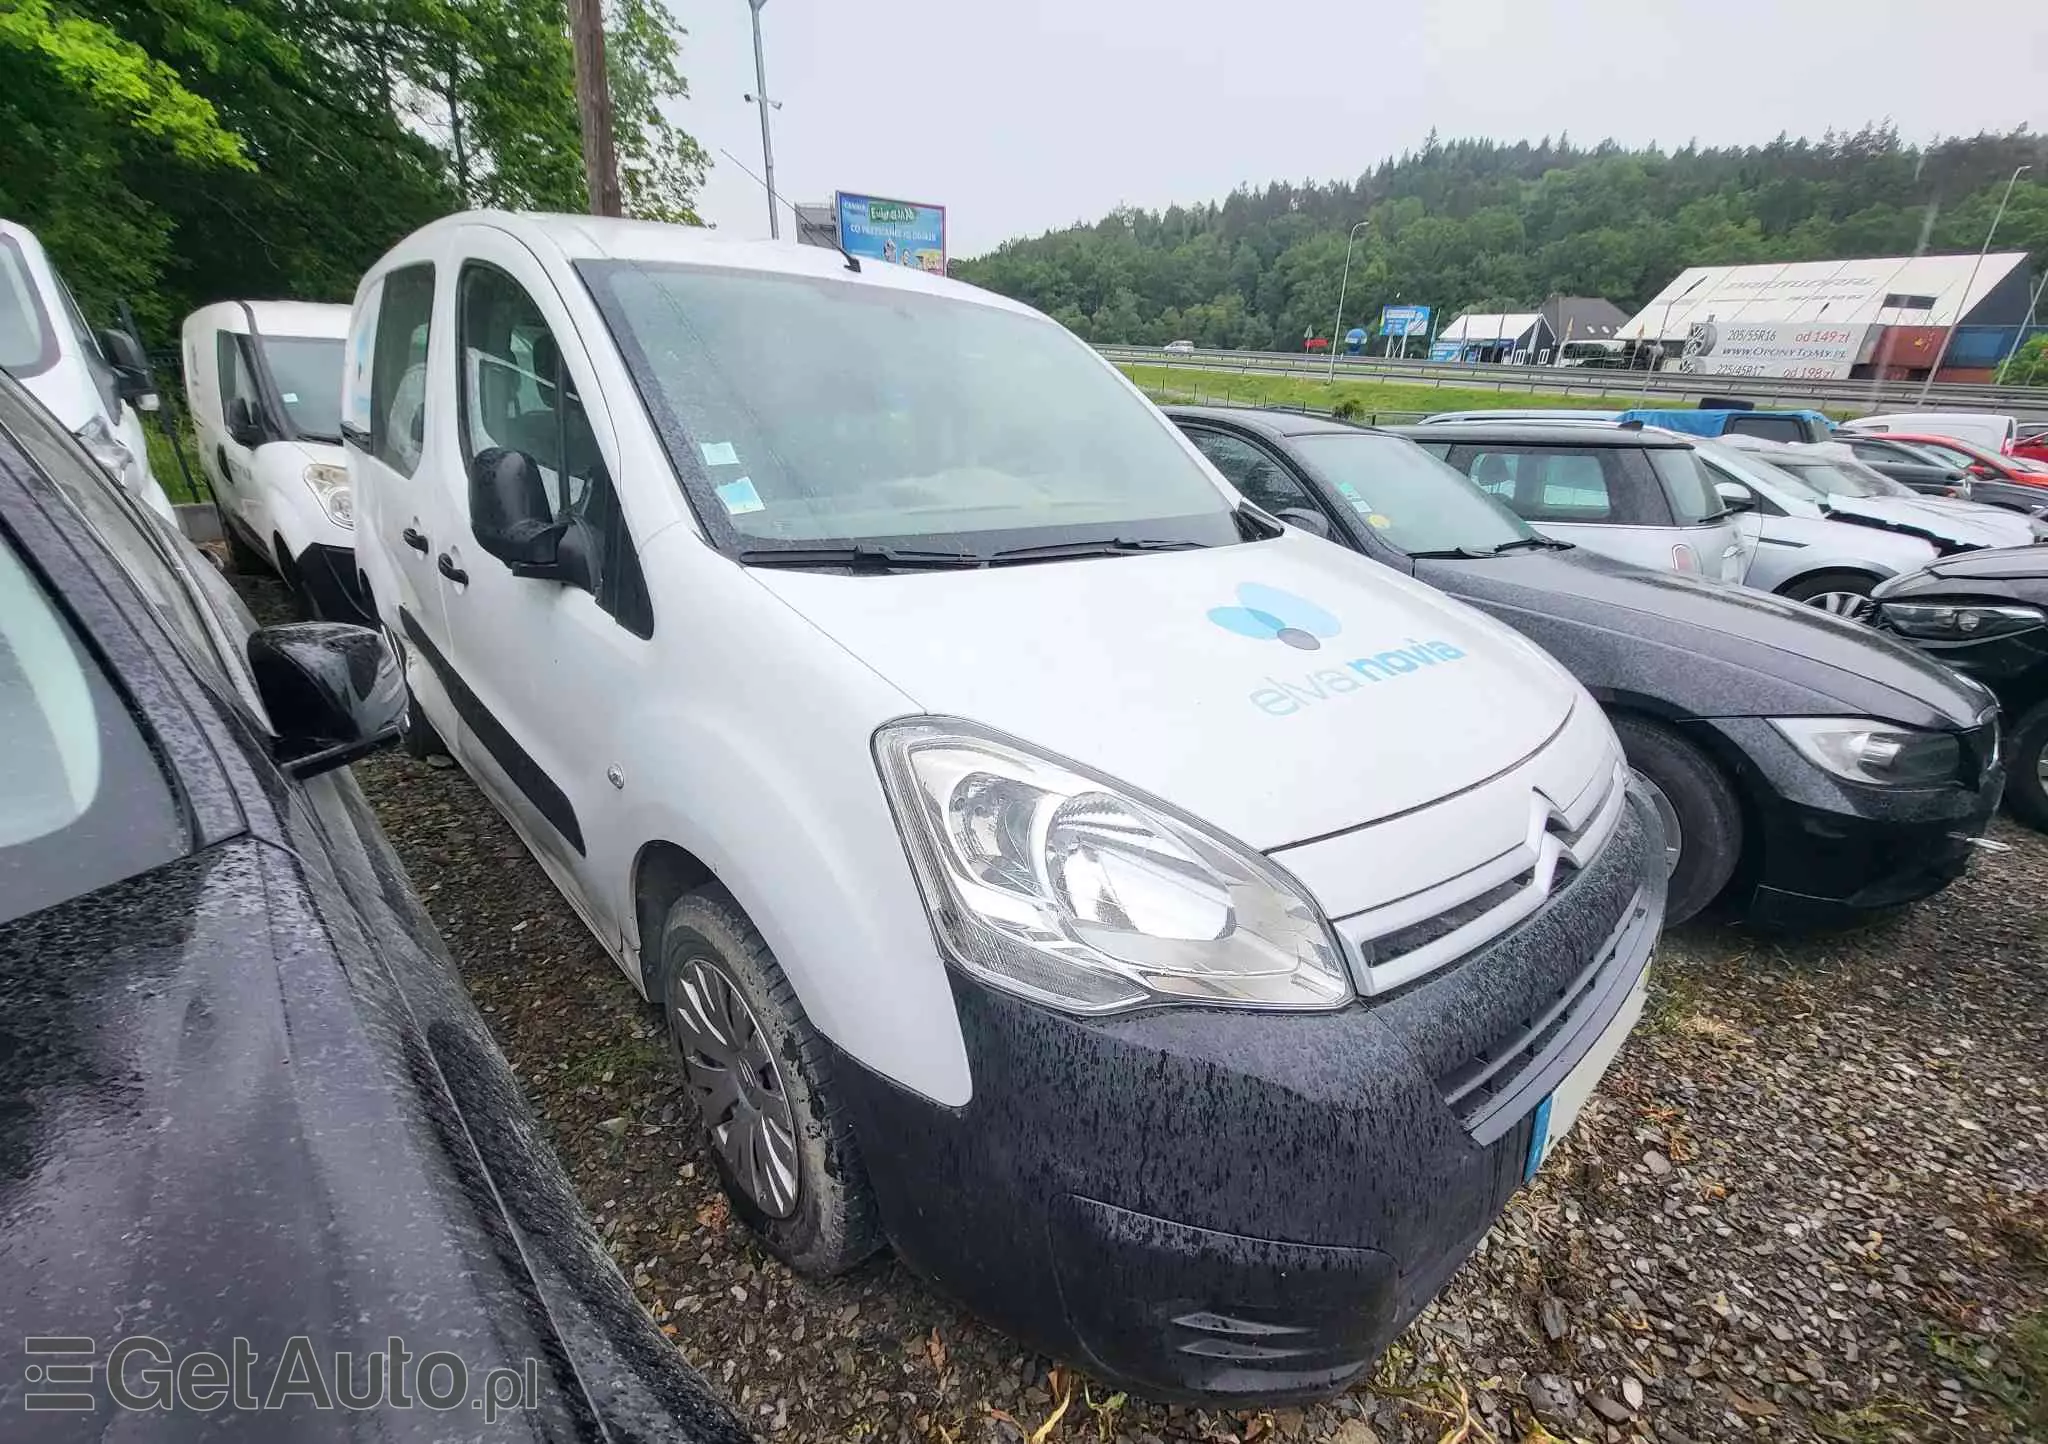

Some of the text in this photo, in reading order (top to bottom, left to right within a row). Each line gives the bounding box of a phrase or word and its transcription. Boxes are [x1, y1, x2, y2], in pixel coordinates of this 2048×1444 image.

[1727, 328, 1777, 342] 205/55R16
[1795, 331, 1812, 342] od
[1783, 367, 1798, 377] od
